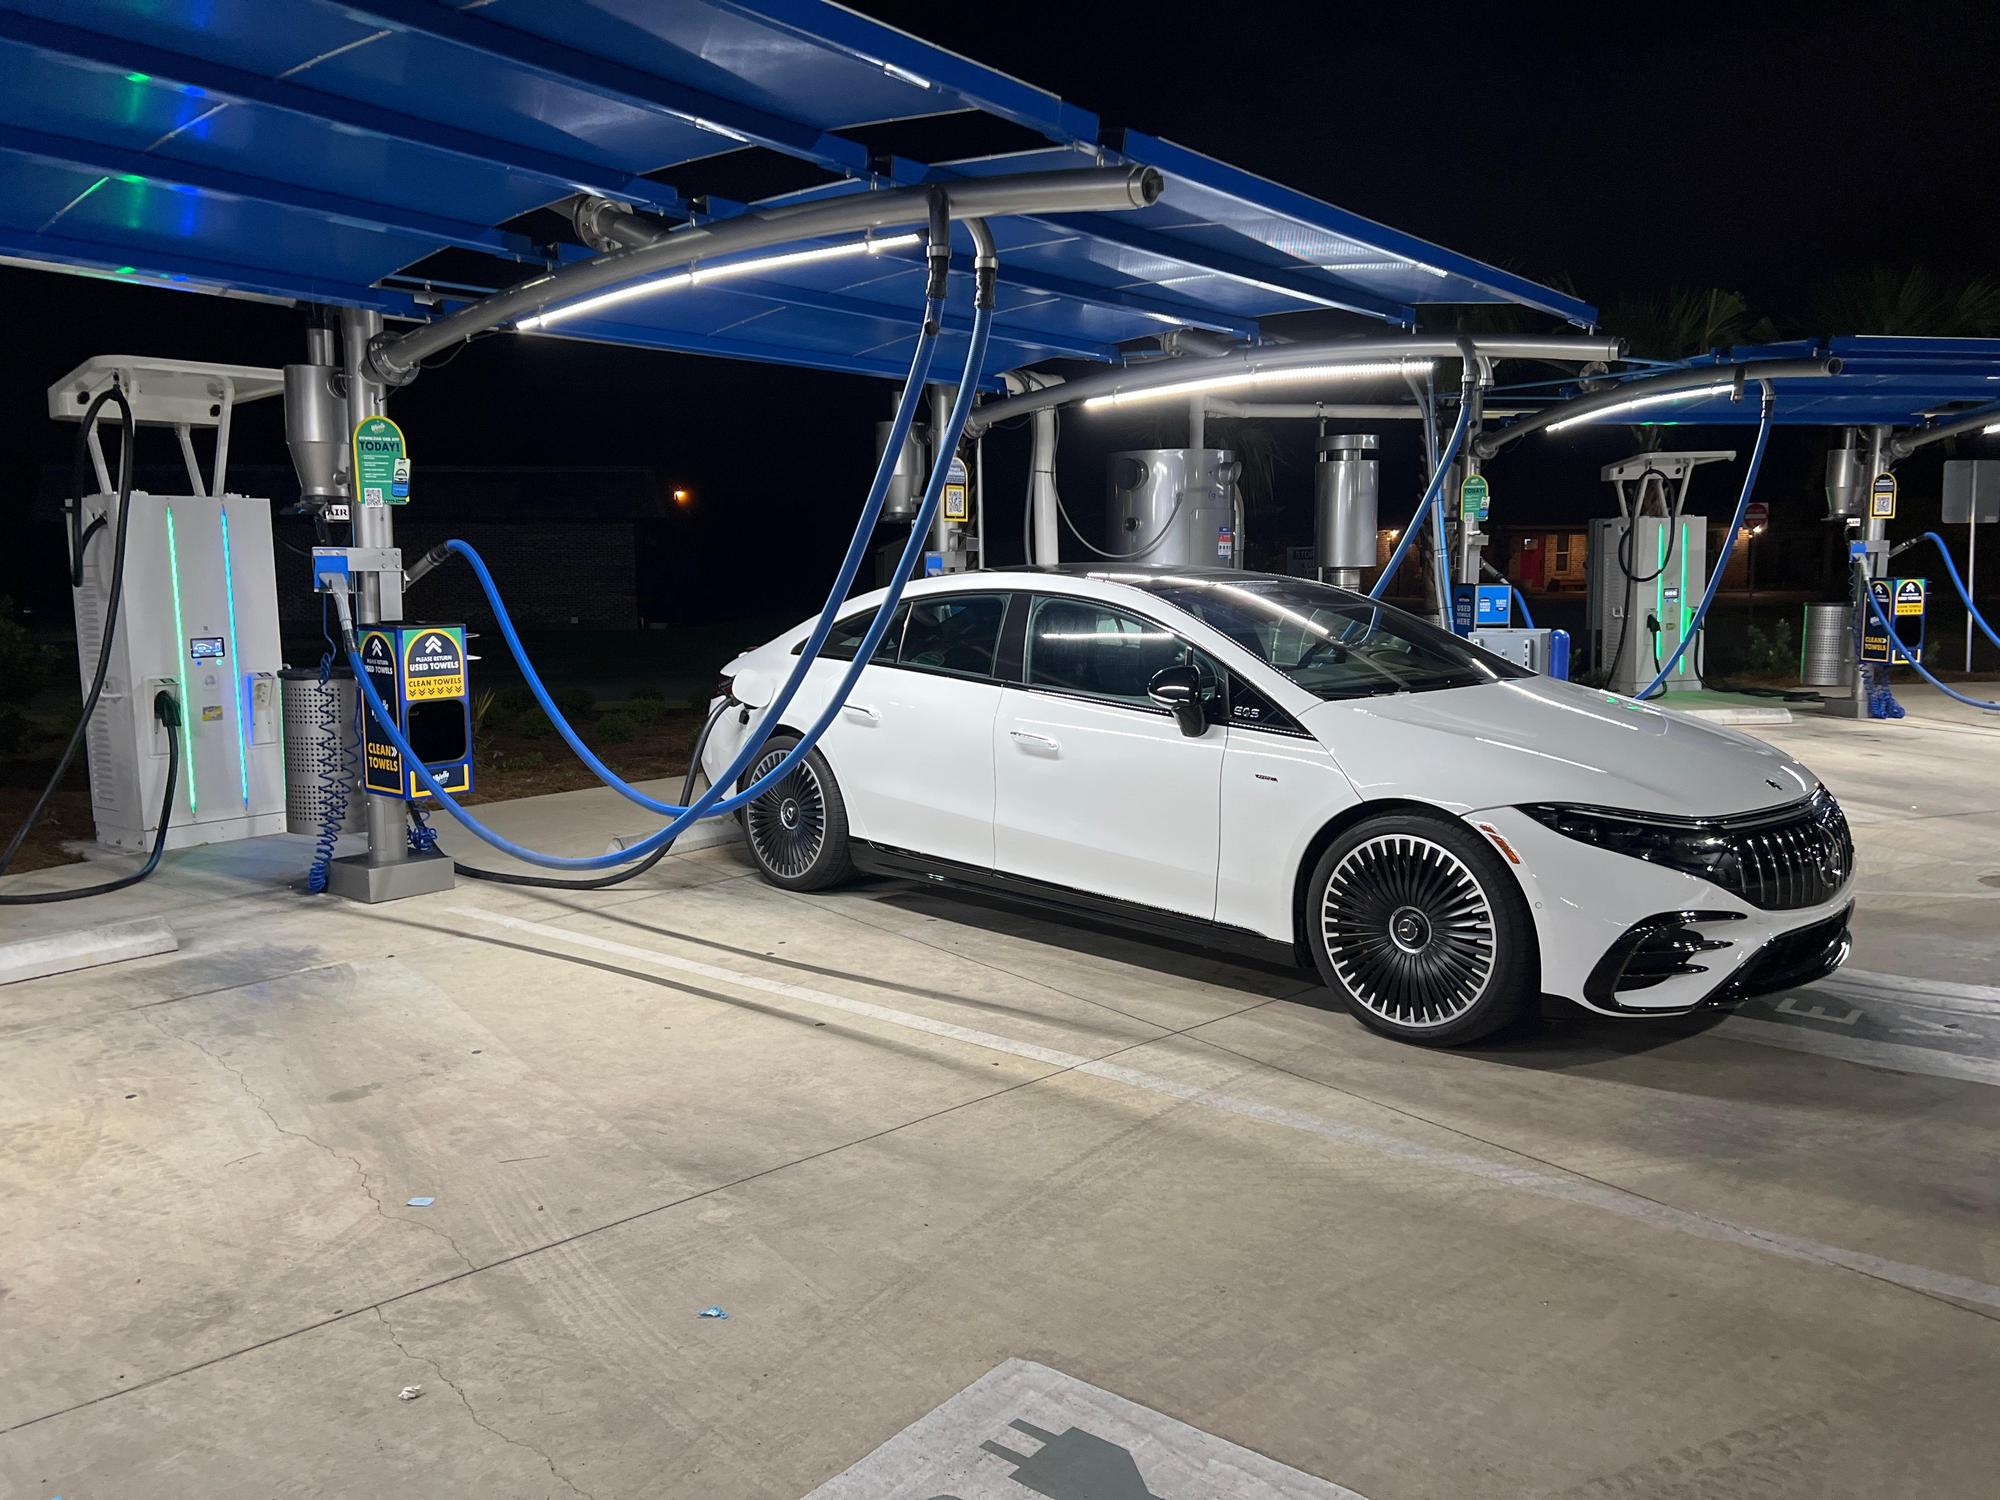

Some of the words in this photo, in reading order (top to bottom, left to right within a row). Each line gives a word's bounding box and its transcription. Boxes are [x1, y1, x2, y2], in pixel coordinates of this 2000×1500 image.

[359, 441, 400, 452] TODAY!
[409, 663, 429, 671] USED
[429, 661, 459, 670] TOWELS
[434, 678, 462, 686] TOWELS
[1233, 705, 1260, 718] EQS
[368, 742, 392, 757] CLEAN
[368, 756, 398, 772] TOWELS
